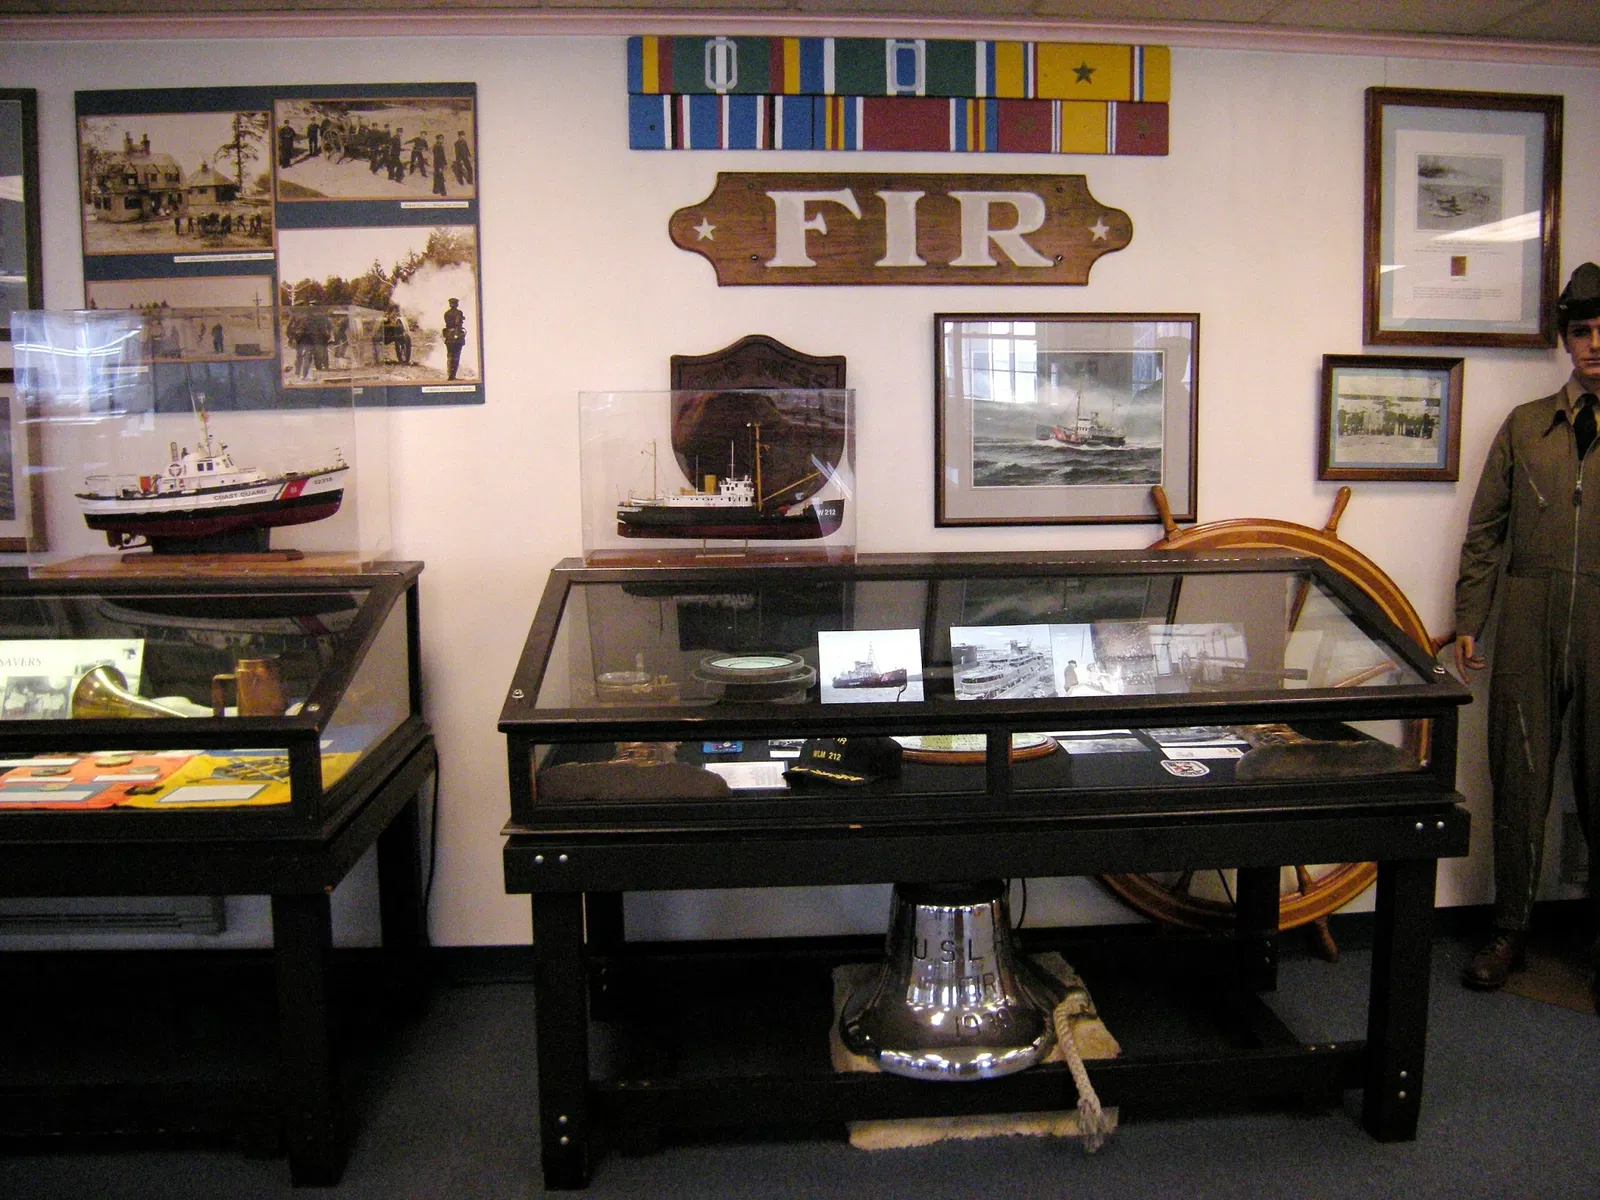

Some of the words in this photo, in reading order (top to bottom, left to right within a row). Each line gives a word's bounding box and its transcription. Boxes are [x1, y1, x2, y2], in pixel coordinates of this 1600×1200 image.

[765, 188, 1055, 267] FIR
[213, 493, 238, 501] COAST
[240, 489, 267, 498] GUARD
[828, 753, 842, 761] 212
